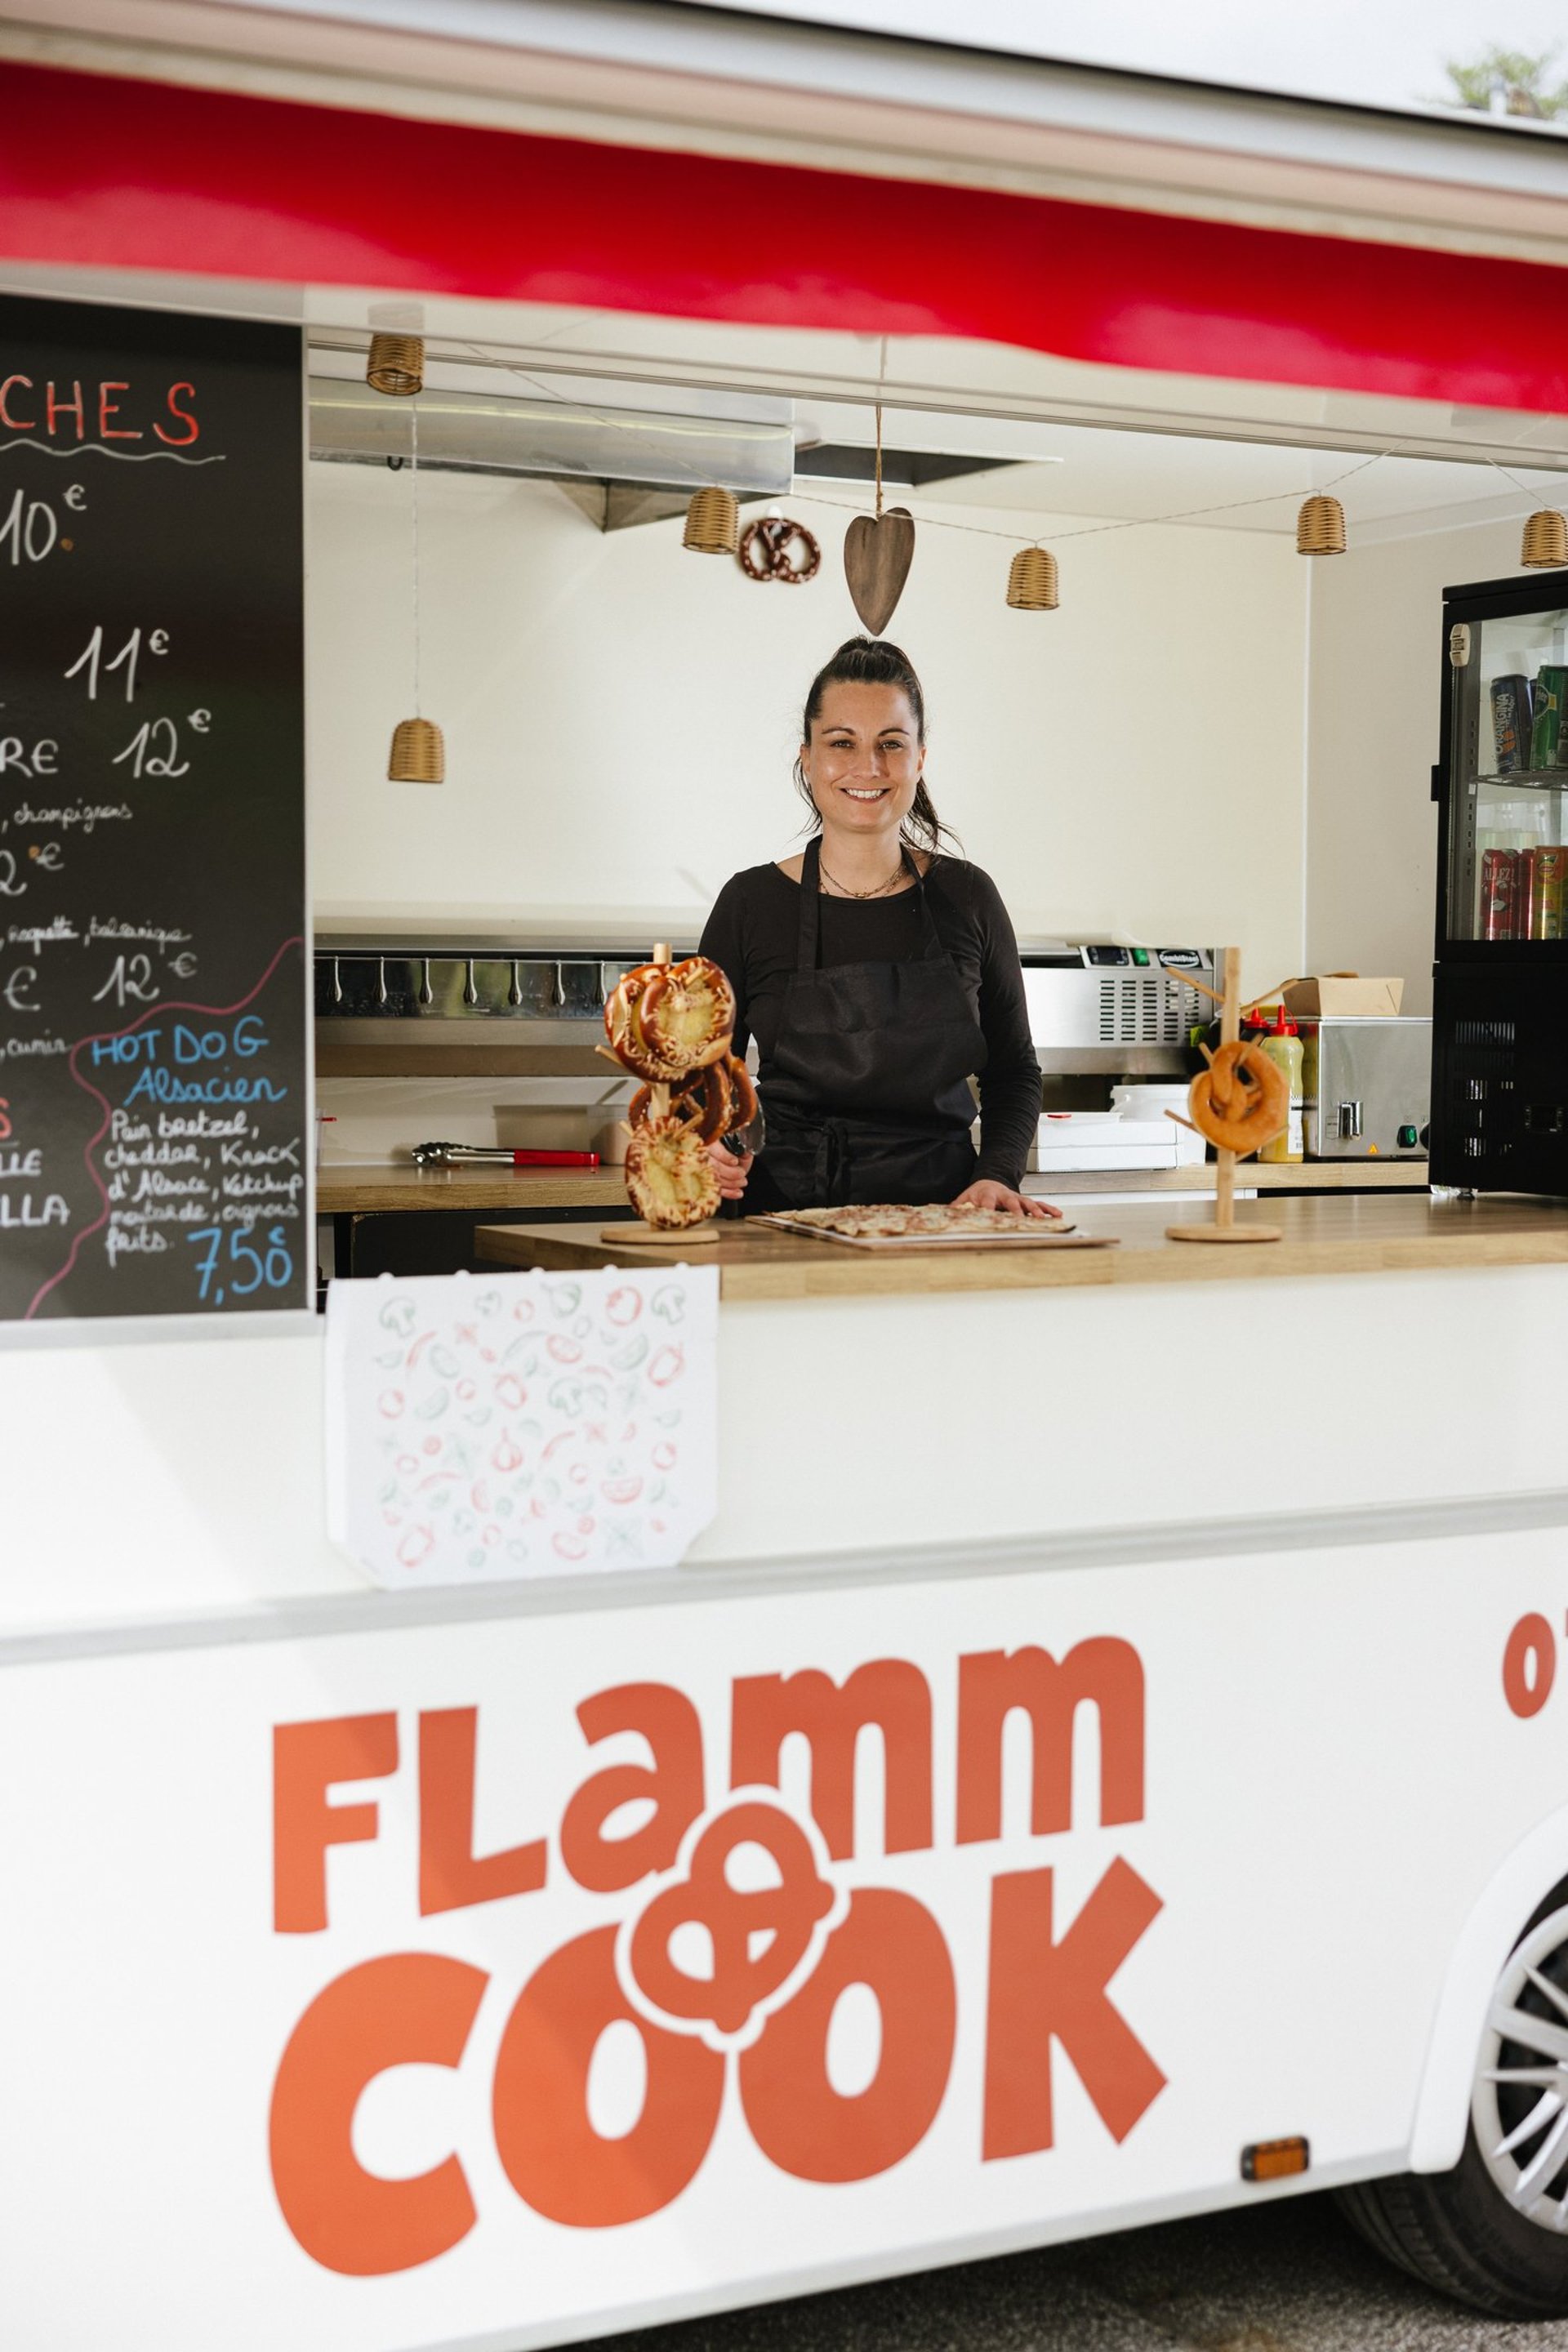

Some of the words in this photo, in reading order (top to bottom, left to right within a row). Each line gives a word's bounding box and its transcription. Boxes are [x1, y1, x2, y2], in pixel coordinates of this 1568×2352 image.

[0, 375, 199, 446] CHES
[91, 1029, 162, 1066] HOT
[174, 1015, 270, 1064] DOG
[123, 1067, 287, 1106] Alsacien
[111, 1108, 153, 1142] Pain
[268, 1853, 1169, 2278] COOK
